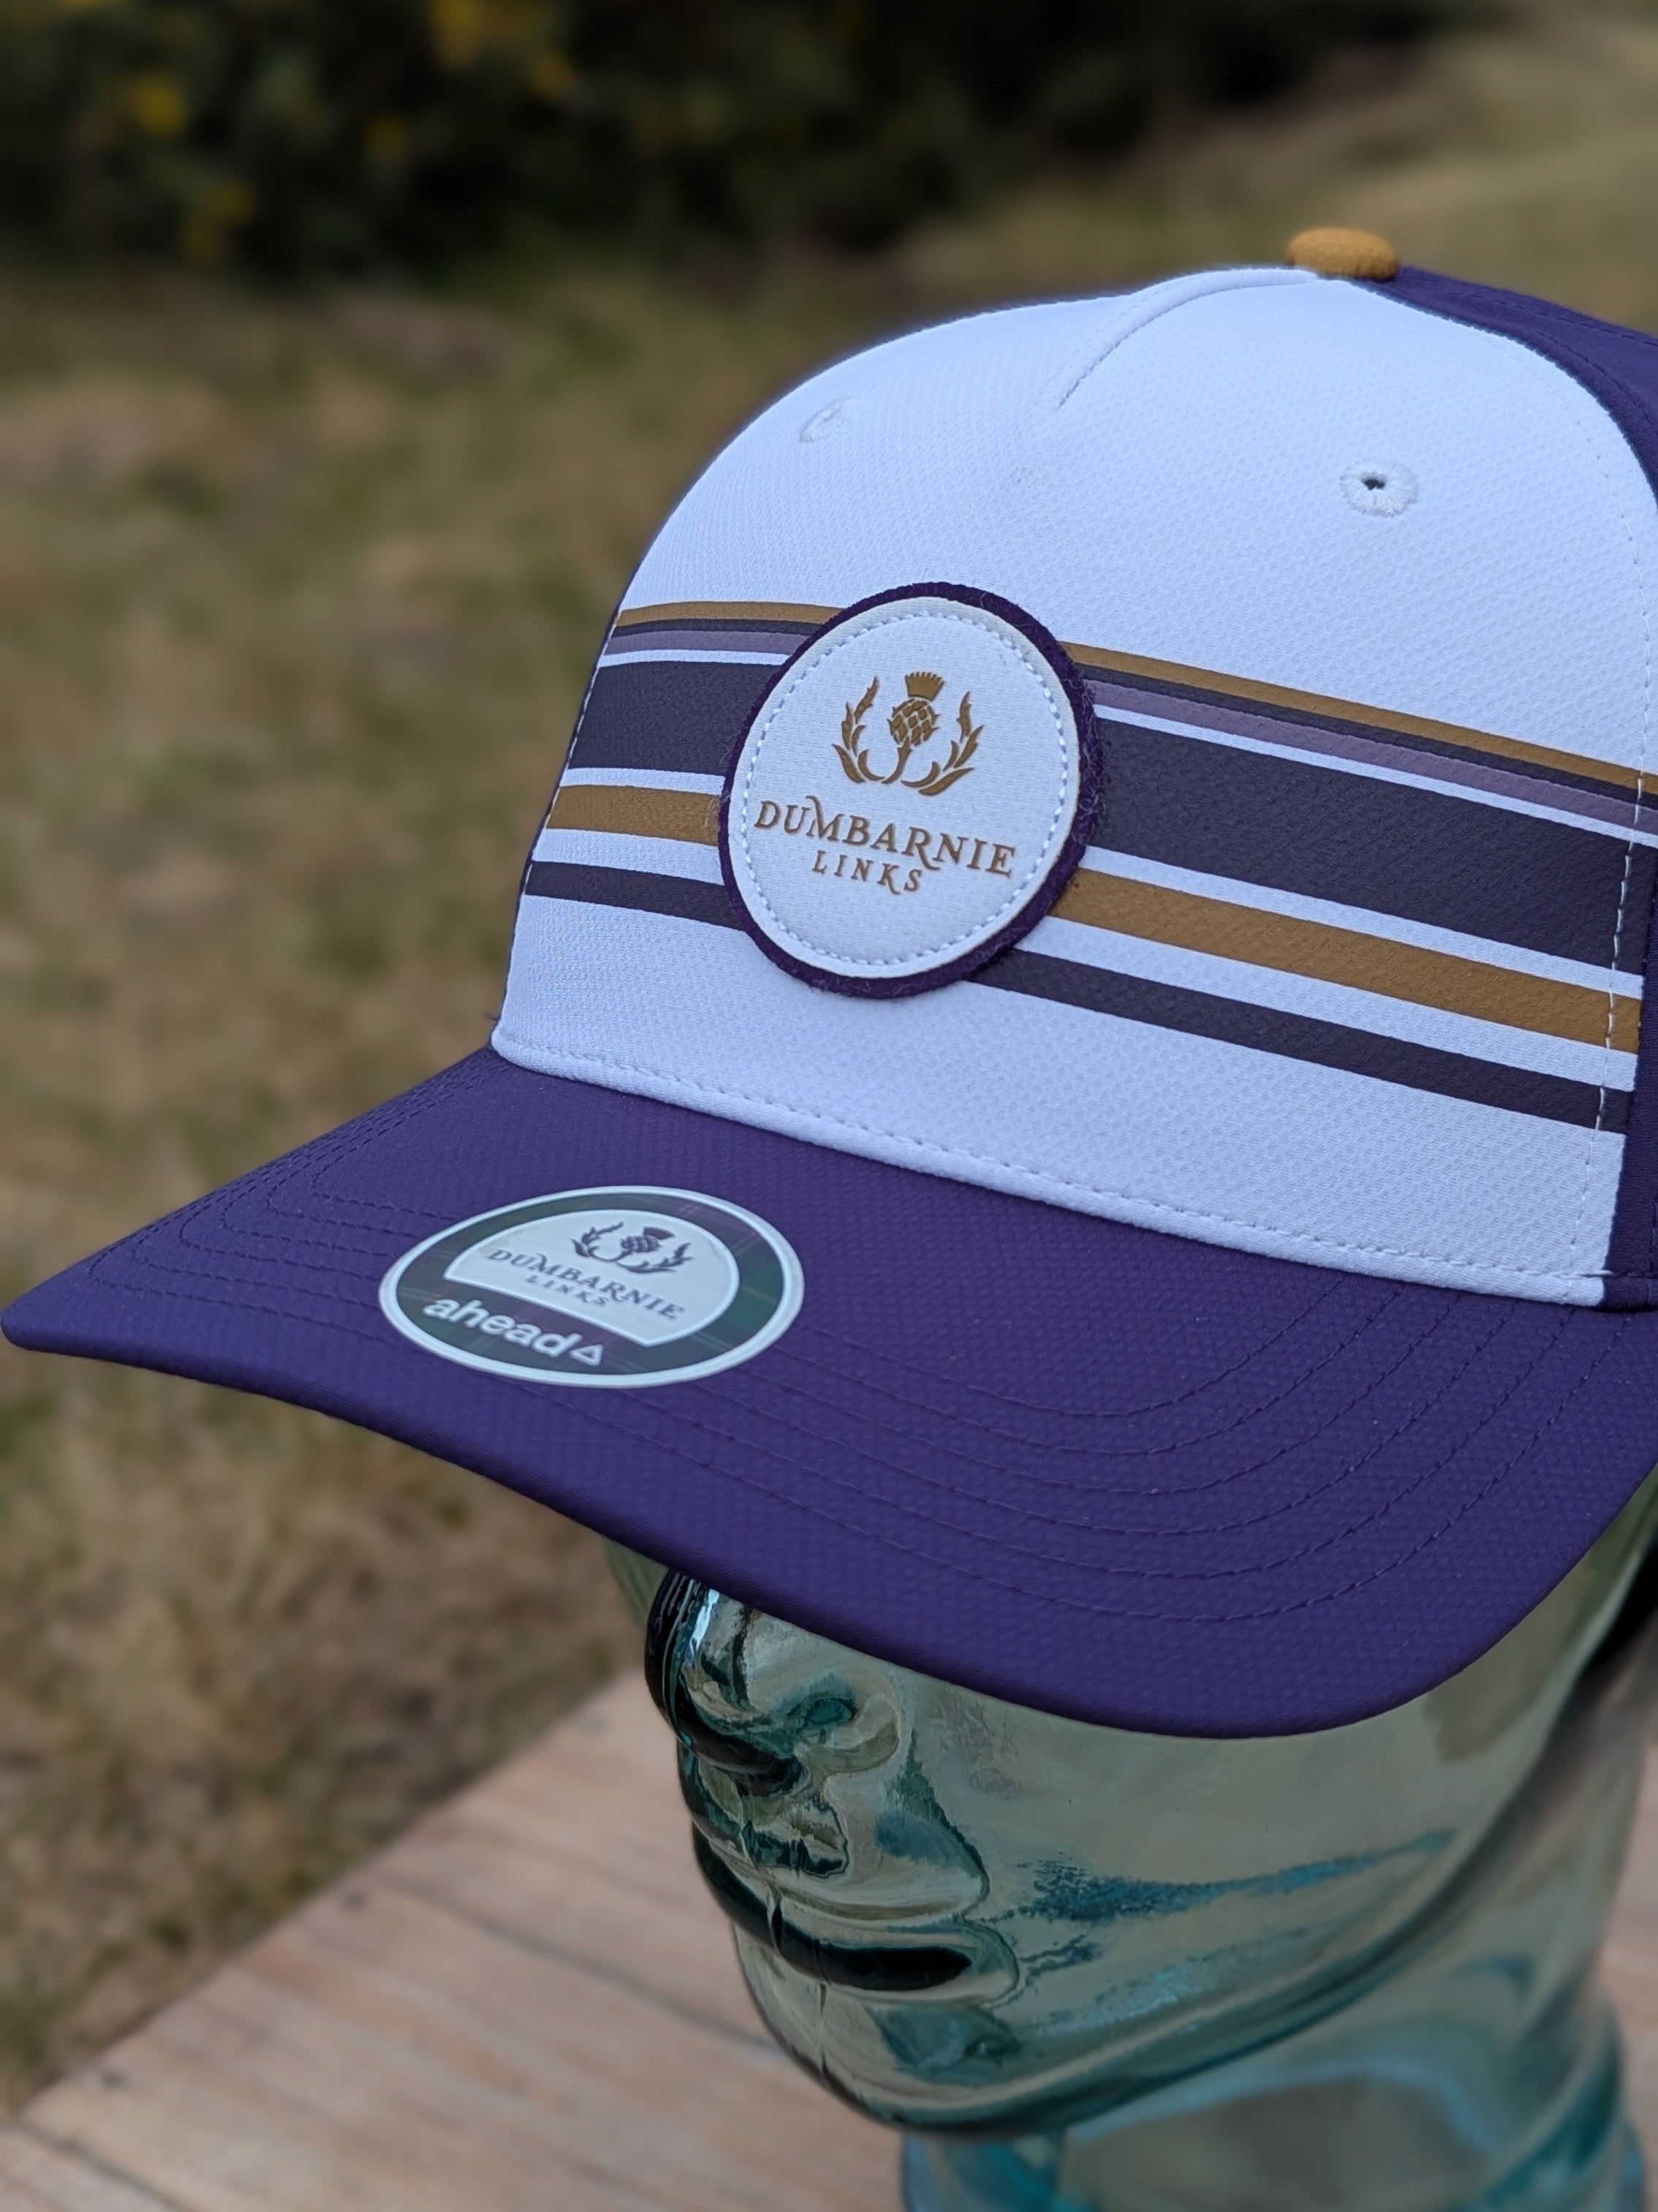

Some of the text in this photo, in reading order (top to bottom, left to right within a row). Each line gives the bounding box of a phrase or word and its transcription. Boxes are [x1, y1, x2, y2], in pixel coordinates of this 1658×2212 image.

[754, 796, 1015, 878] DUMBARNIE
[812, 850, 922, 895] LINKS
[486, 1248, 685, 1319] DUMBARNIE
[526, 1276, 609, 1307] LINKS
[423, 1298, 583, 1358] ahead
